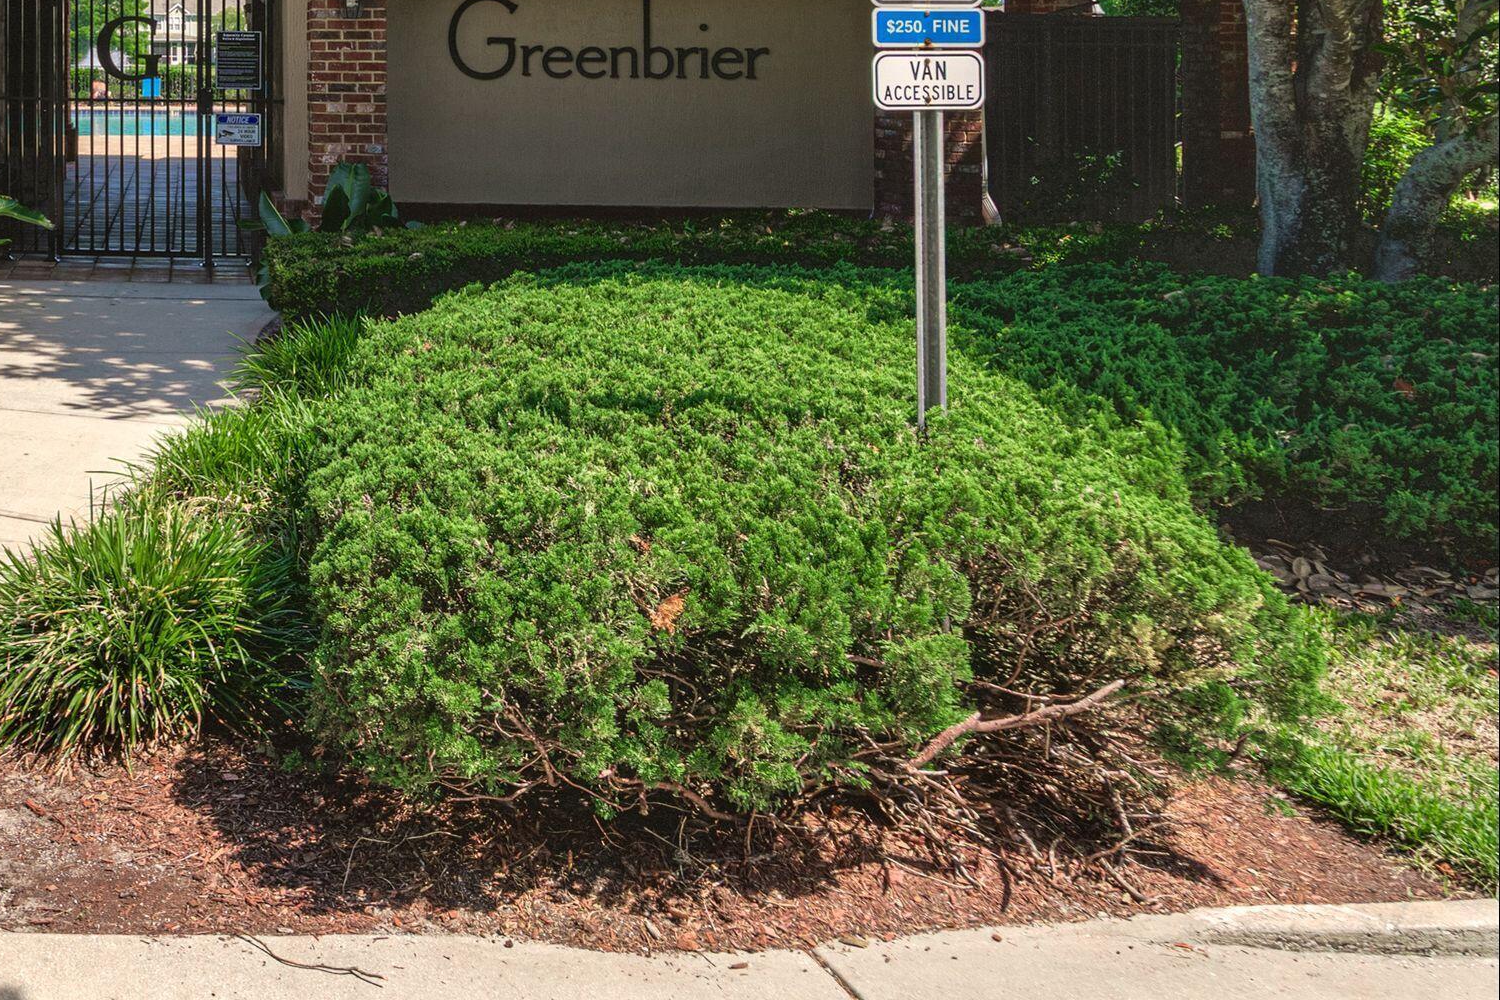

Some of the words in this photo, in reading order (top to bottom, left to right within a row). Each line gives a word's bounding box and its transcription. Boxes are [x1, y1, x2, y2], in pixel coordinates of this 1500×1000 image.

[886, 20, 927, 34] $250.
[932, 19, 971, 34] FINE
[97, 16, 162, 81] G
[910, 60, 948, 81] VAN
[884, 85, 975, 101] ACCESSIBLE
[226, 115, 249, 124] NOTICE
